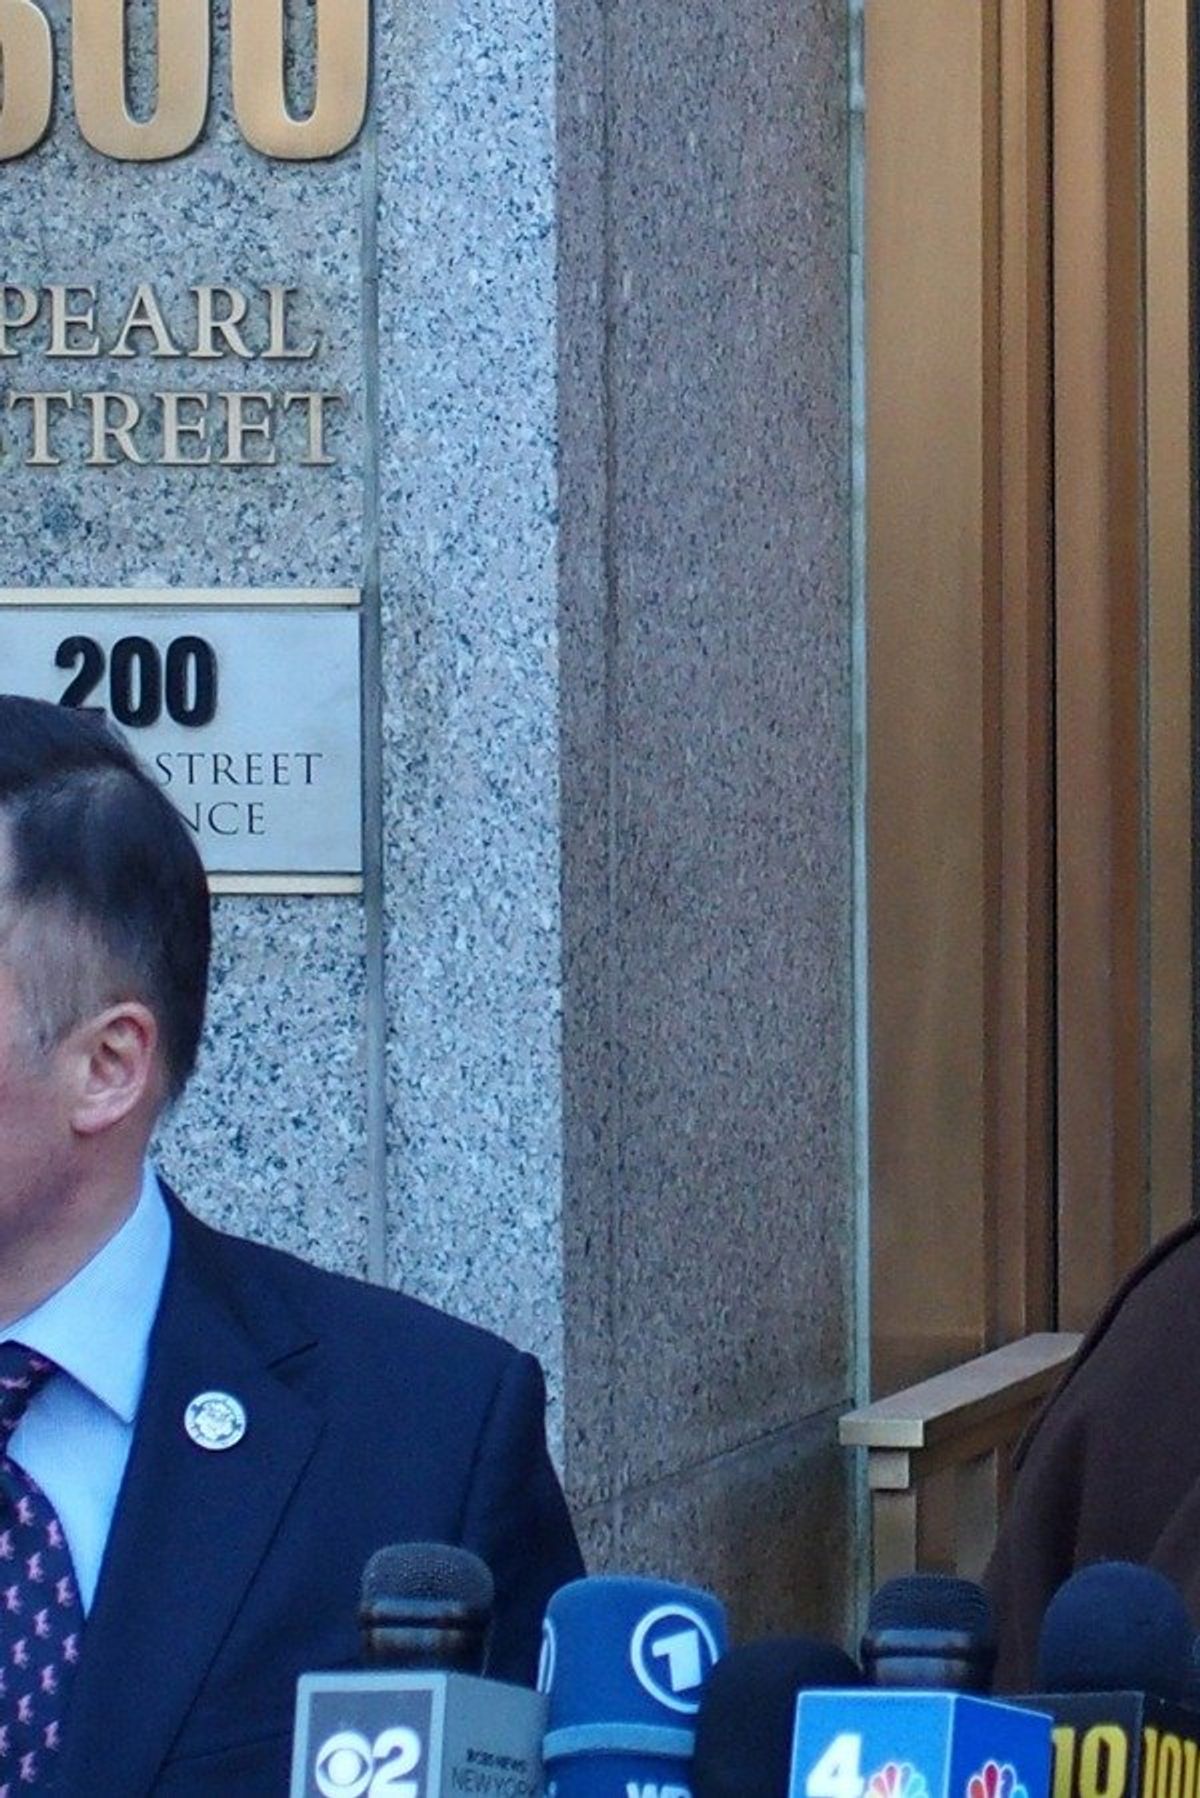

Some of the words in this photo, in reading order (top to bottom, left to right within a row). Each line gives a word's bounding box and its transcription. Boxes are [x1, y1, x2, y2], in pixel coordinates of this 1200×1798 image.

[0, 284, 318, 357] PEARL
[0, 390, 342, 465] TREET
[55, 635, 218, 728] 200
[155, 752, 323, 786] STREET
[806, 1733, 864, 1798] 4
